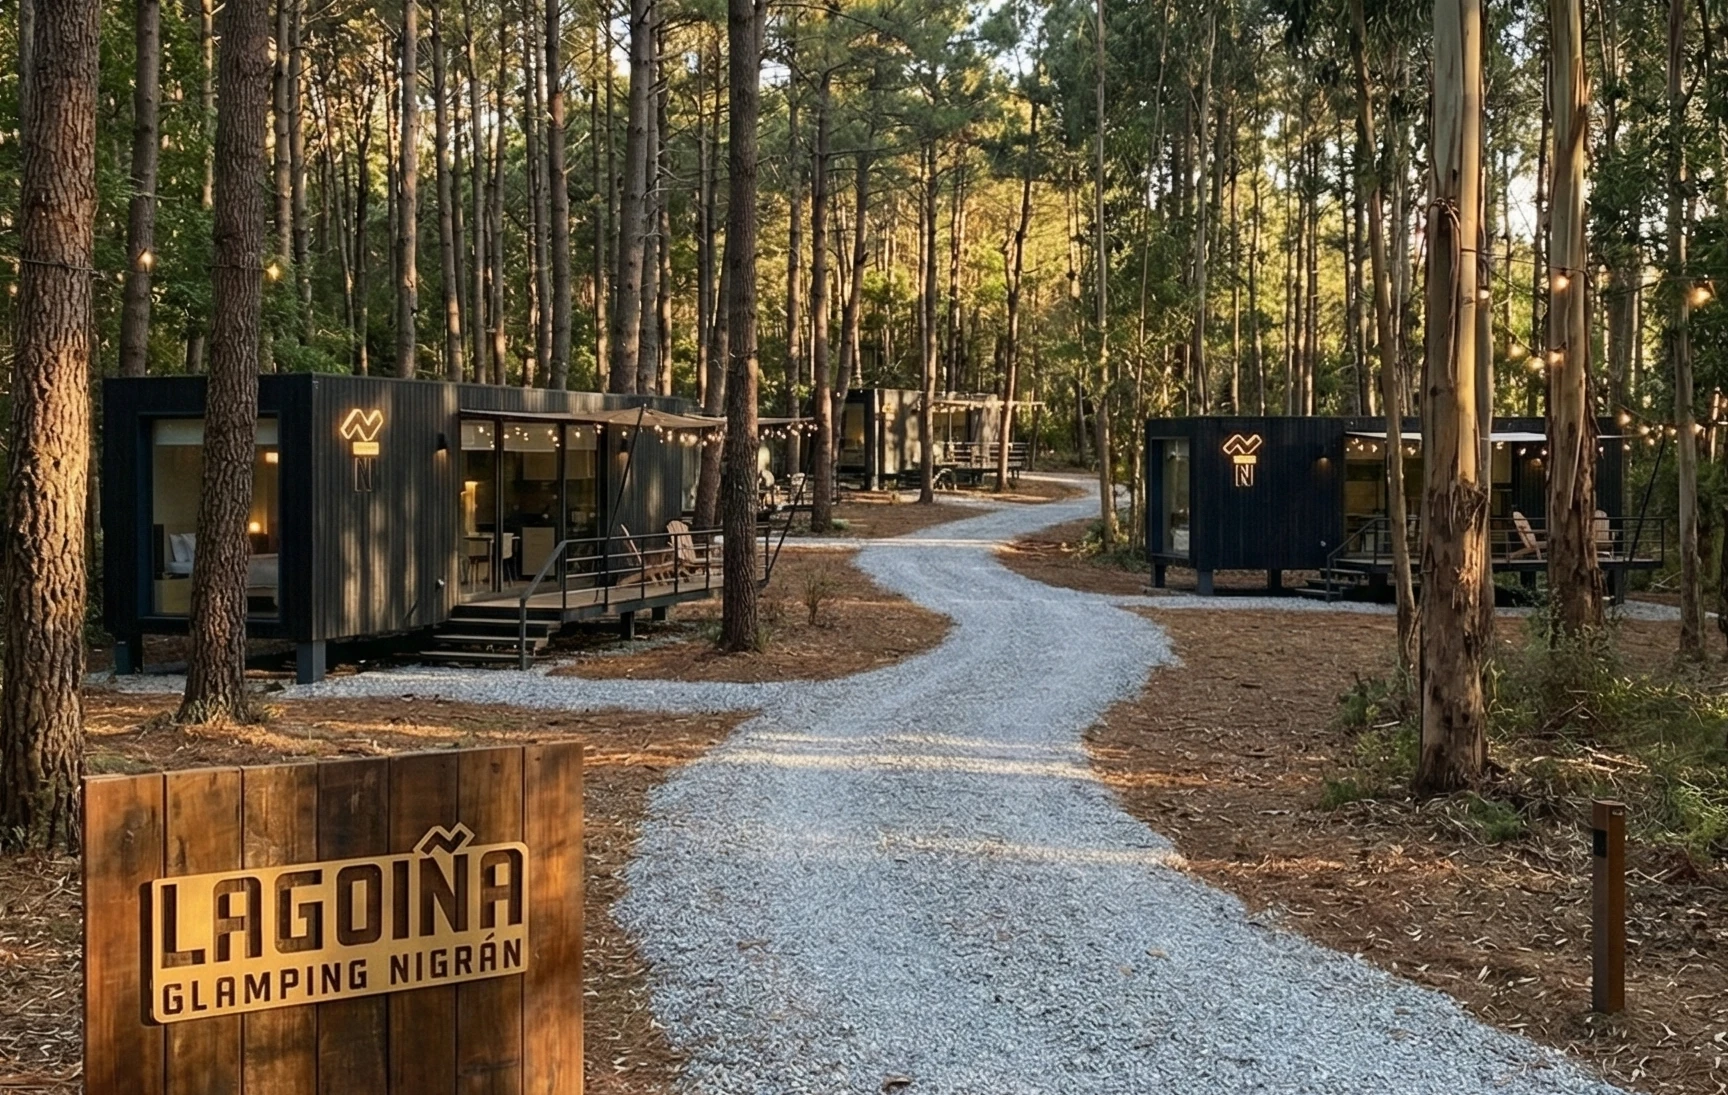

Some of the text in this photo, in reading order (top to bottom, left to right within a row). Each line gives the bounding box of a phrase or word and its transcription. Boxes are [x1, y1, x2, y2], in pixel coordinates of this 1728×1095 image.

[160, 823, 524, 969] LAGOIÑA
[162, 932, 523, 1016] GLAMPING NIGRÁN
